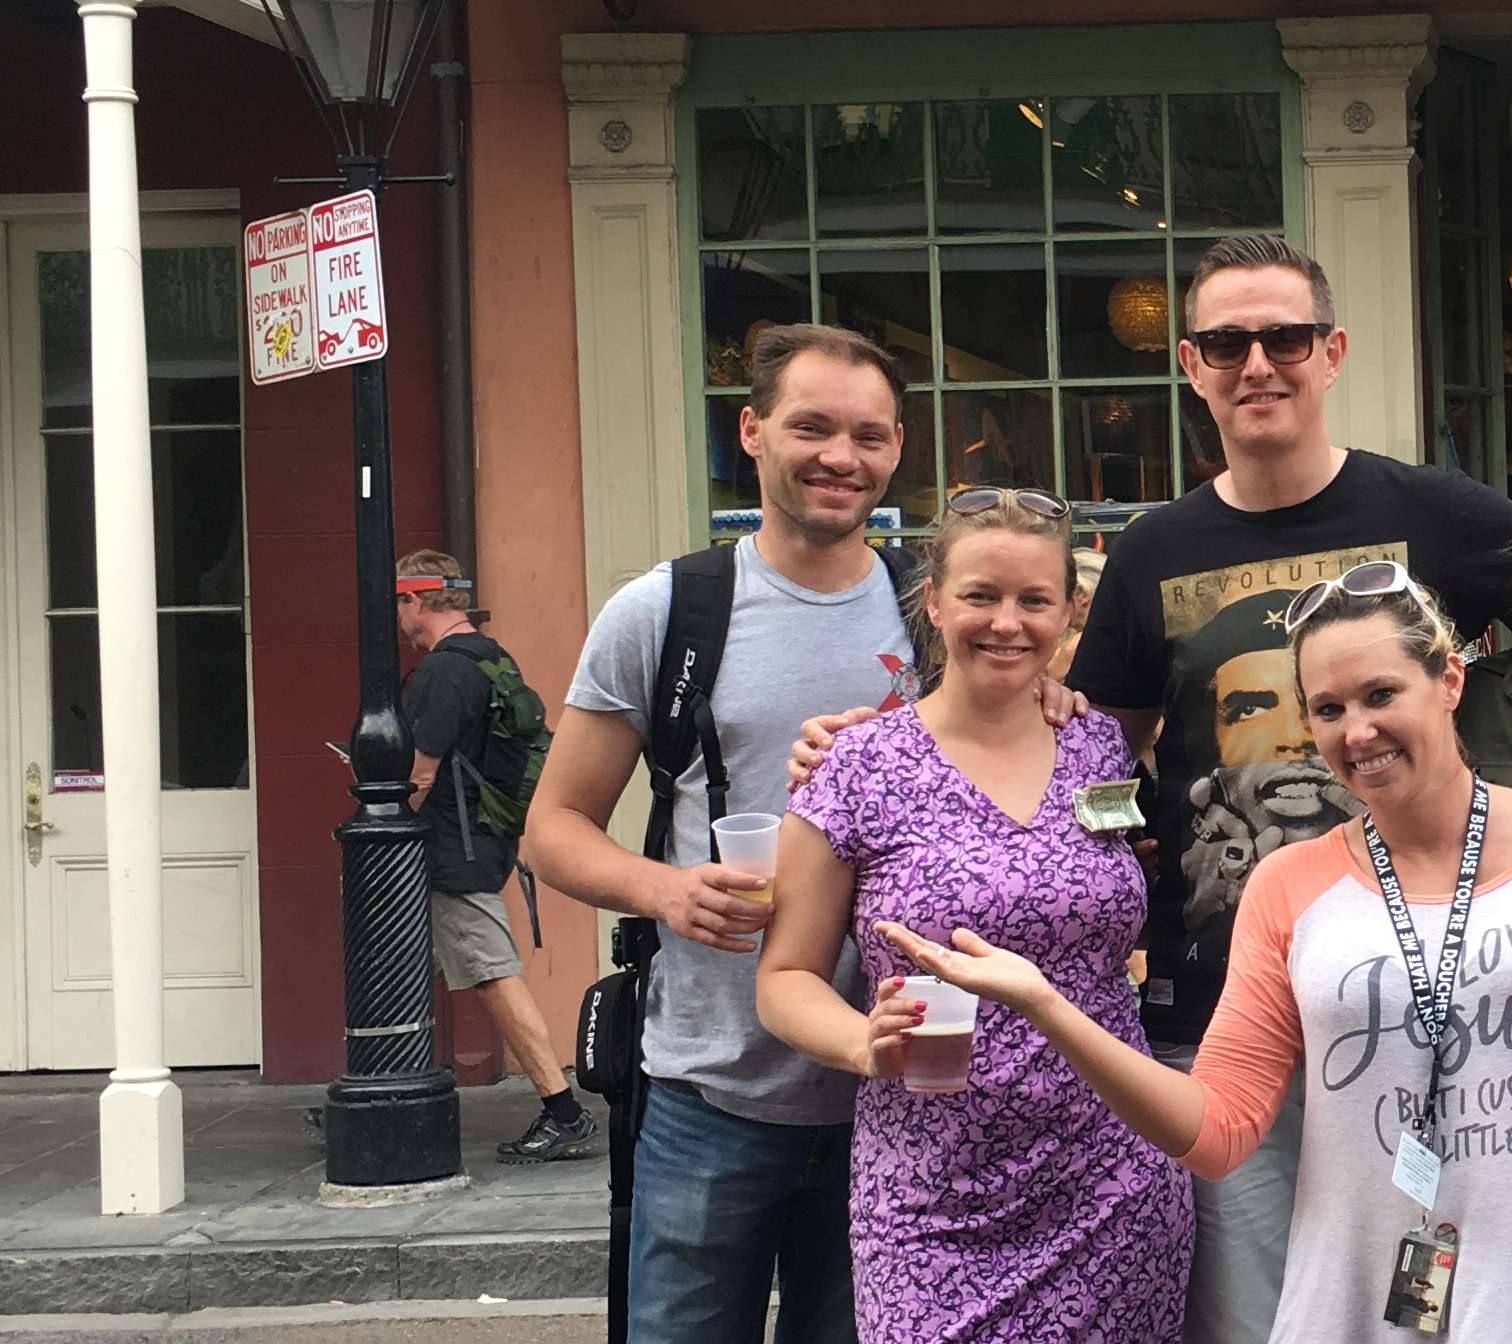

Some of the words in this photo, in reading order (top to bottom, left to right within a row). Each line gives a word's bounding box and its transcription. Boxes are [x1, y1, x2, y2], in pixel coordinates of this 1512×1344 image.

[314, 212, 333, 244] NO
[334, 200, 371, 222] STOPPING
[338, 221, 370, 238] ANYTIME
[249, 231, 264, 260] NO
[267, 223, 306, 253] PARKING
[271, 262, 287, 283] ON
[329, 251, 362, 283] FIRE
[254, 284, 307, 315] SIDEWALK
[328, 286, 368, 317] LANE
[1473, 789, 1488, 812] ME
[1365, 831, 1394, 875] YOU'RE
[1460, 813, 1486, 875] BECAUSE
[1380, 875, 1412, 930] BECAUSE
[1448, 878, 1474, 930] YOU'RE
[1400, 931, 1419, 950] ME
[1444, 934, 1461, 944] A
[1406, 953, 1430, 990] HATE
[1416, 994, 1438, 1046] DON'T
[1460, 1088, 1465, 1115] I
